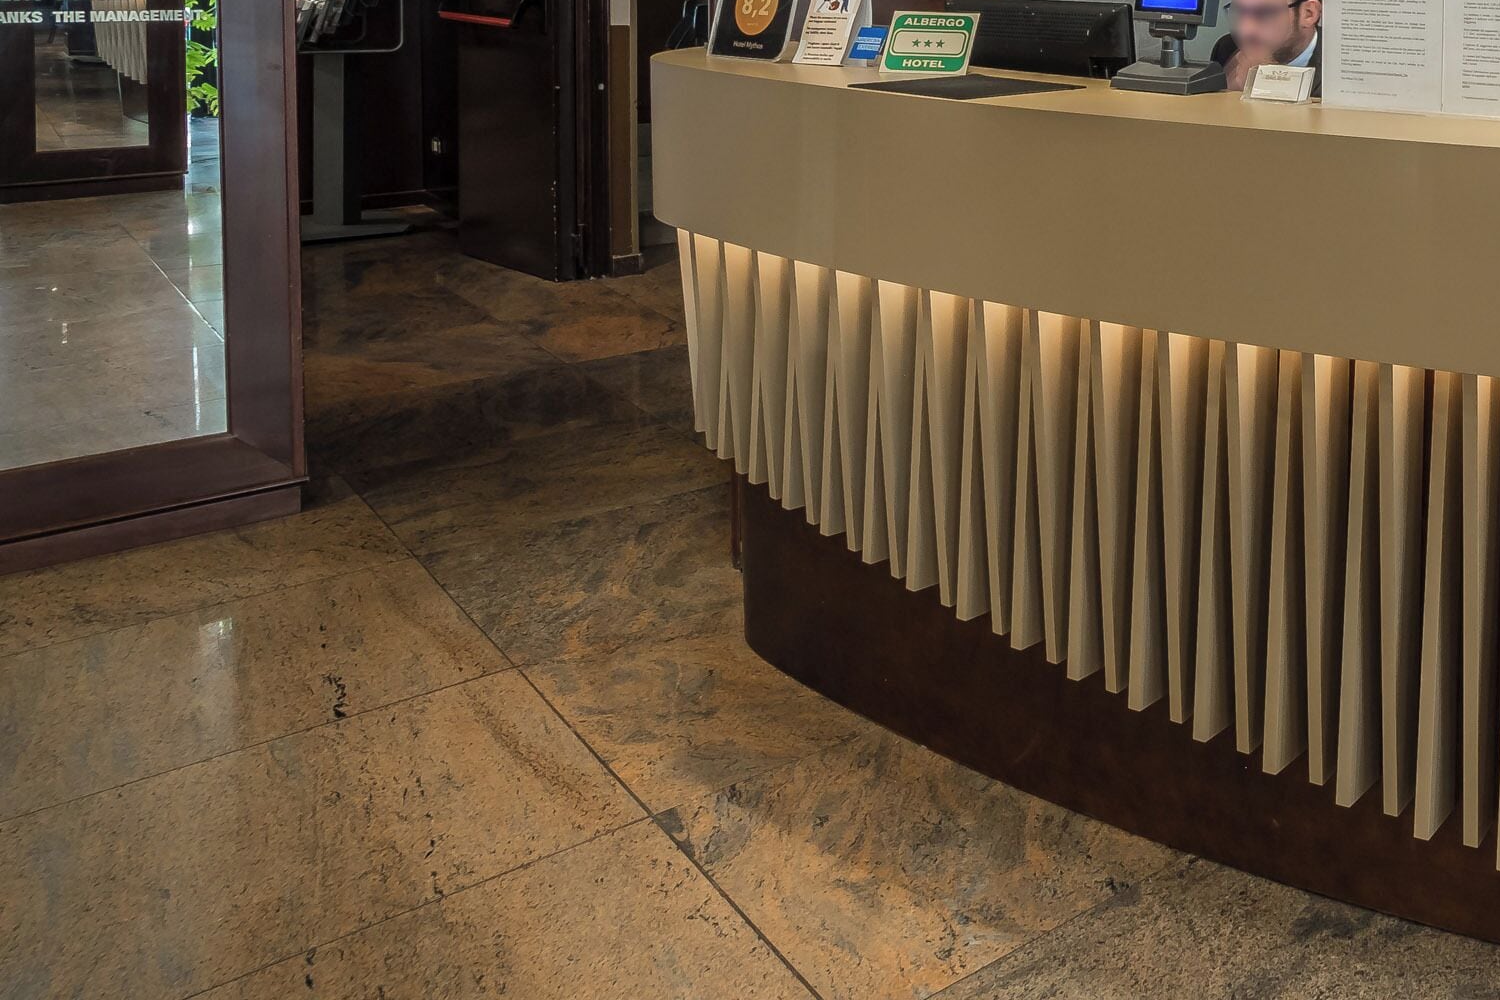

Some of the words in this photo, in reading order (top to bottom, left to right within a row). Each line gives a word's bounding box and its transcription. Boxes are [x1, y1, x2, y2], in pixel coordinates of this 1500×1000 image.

[52, 11, 85, 23] THE
[904, 17, 965, 27] ALBERGO
[902, 59, 945, 68] HOTEL
